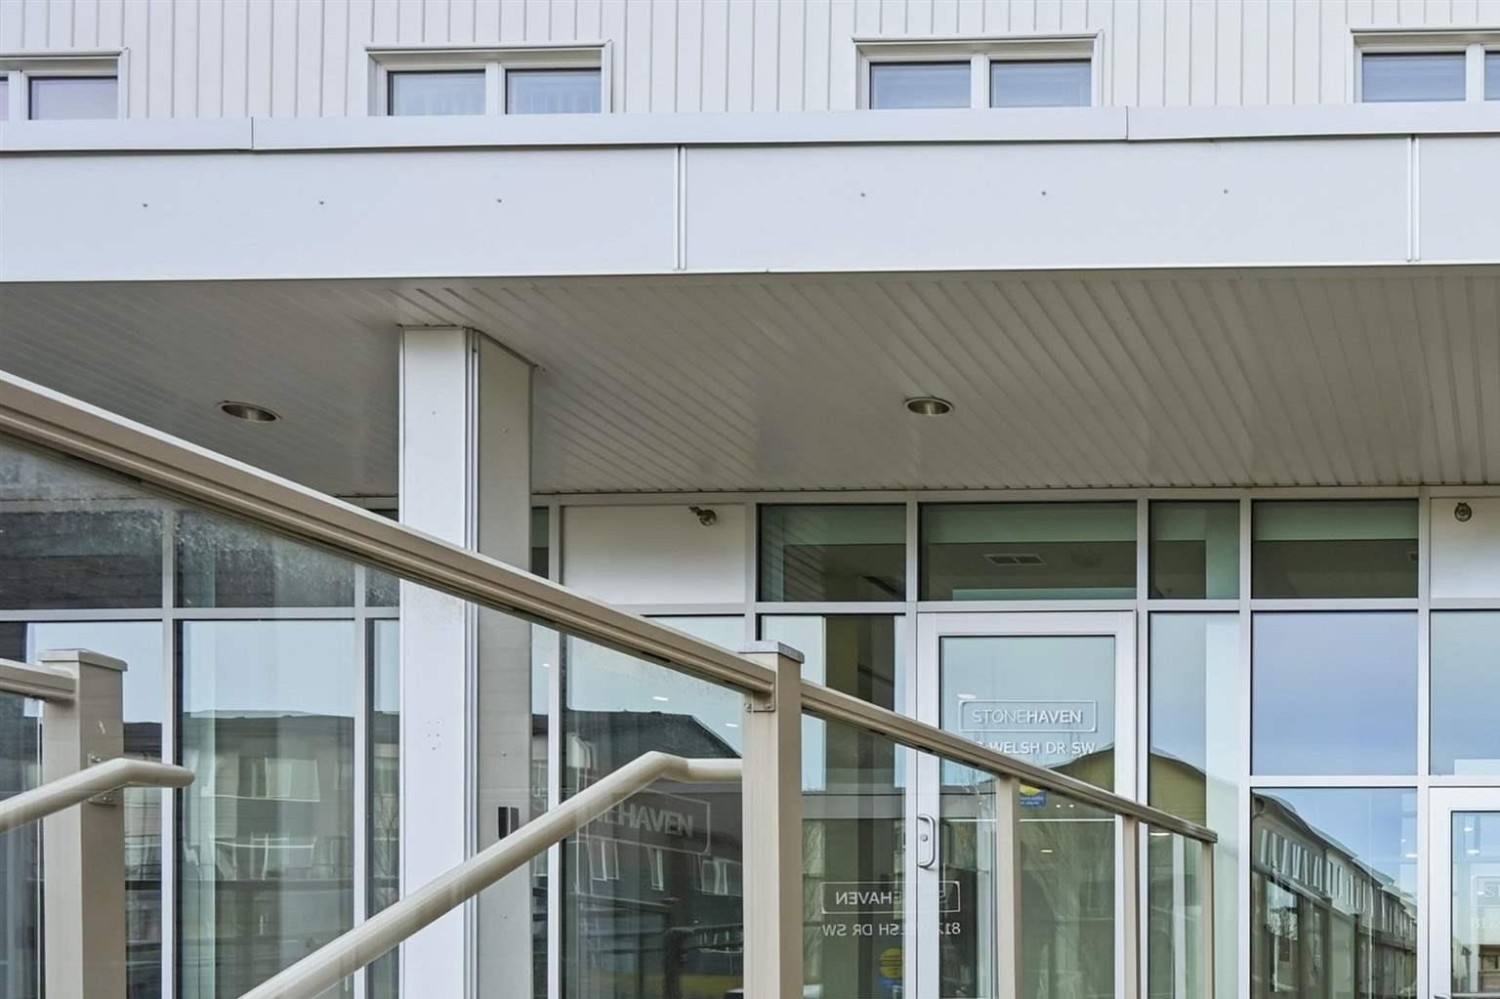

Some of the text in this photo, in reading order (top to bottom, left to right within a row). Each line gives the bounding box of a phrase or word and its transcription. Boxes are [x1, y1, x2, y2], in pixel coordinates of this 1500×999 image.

[972, 709, 1083, 724] STONEHAVEN
[988, 741, 1040, 754] WELSH
[1045, 741, 1067, 754] DR
[1071, 741, 1096, 754] SW
